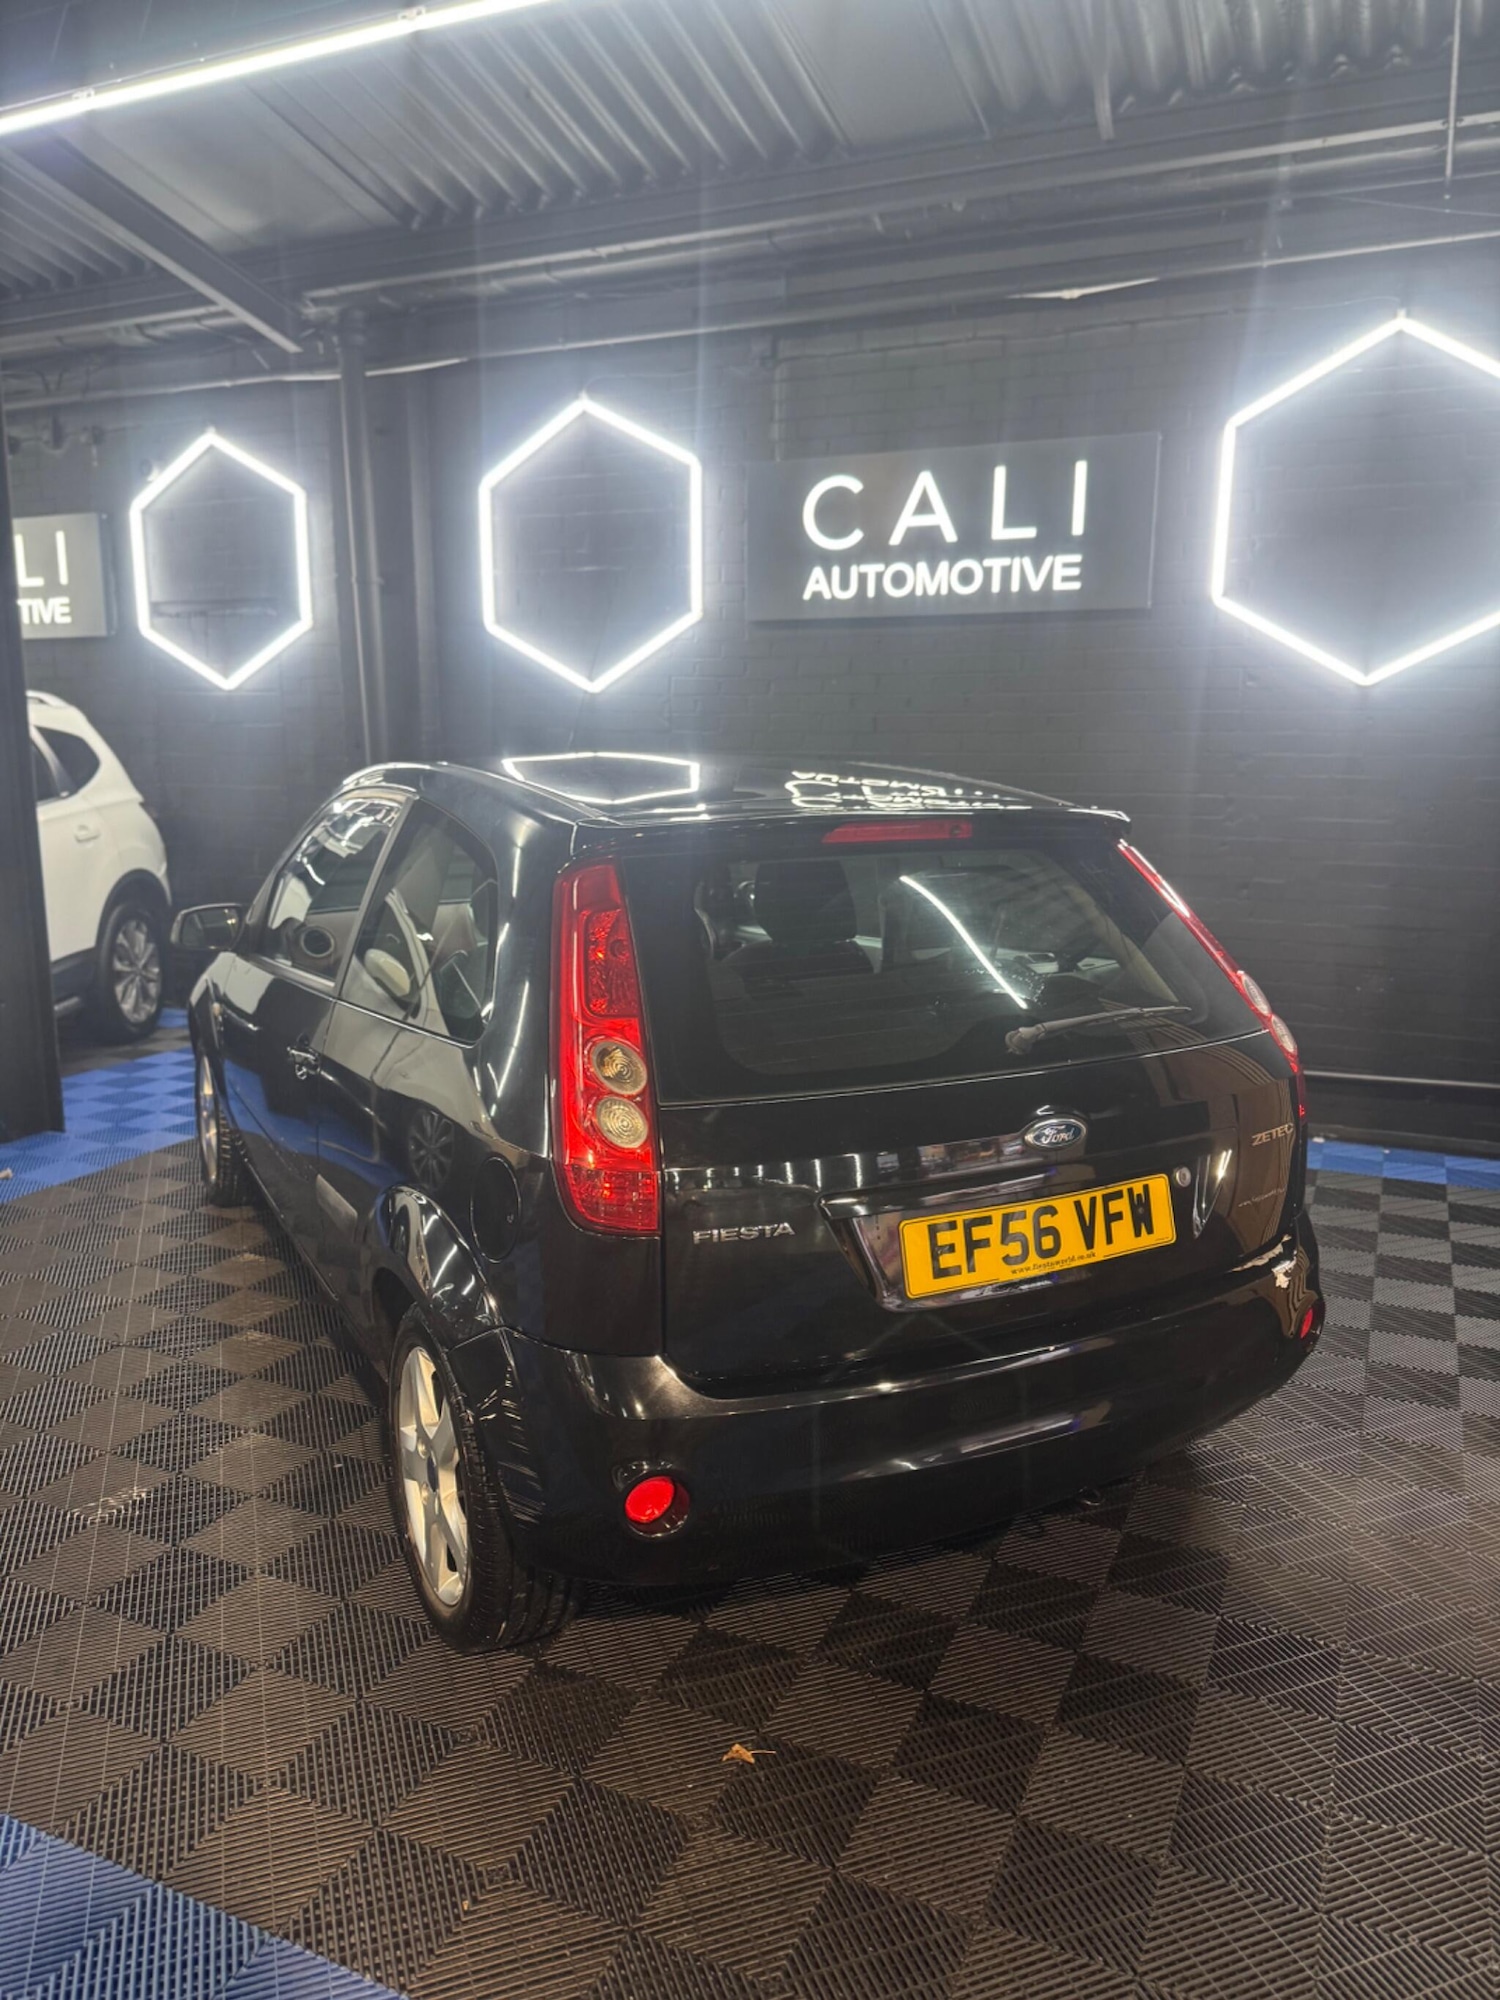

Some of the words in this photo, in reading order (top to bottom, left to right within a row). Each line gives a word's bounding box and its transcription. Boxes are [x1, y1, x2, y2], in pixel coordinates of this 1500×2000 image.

[802, 460, 1088, 551] CALI
[803, 554, 1083, 601] AUTOMOTIVE
[1251, 1122, 1295, 1147] ZETEC
[692, 1222, 796, 1245] FIESTA
[926, 1205, 1062, 1280] EF56
[1073, 1183, 1155, 1251] VFW
